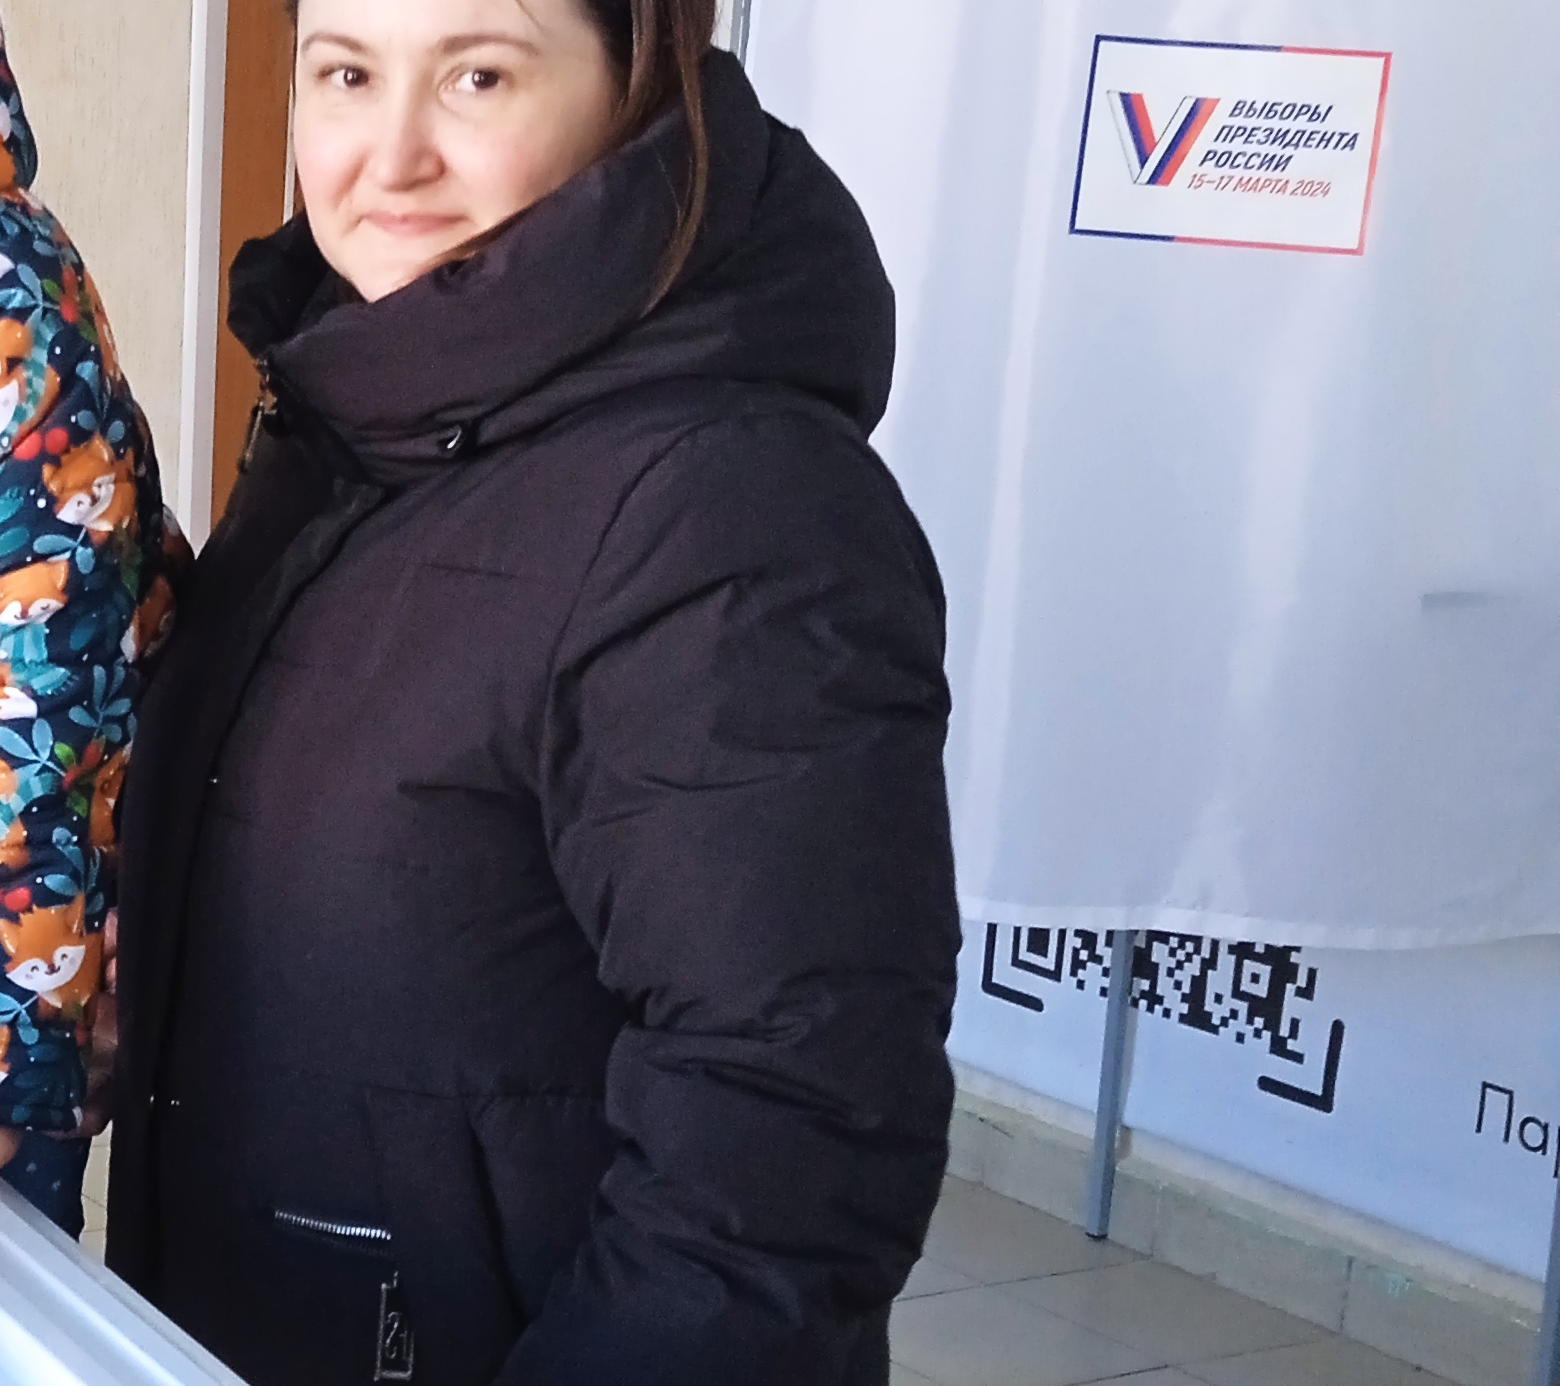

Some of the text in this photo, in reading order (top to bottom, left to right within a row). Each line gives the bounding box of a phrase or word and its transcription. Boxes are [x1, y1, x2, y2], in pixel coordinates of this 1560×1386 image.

[1228, 99, 1333, 124] ВЫБОРЫ
[1213, 124, 1360, 151] ПРЕЗИДЕНТА
[1198, 149, 1295, 173] РОССИИ
[1232, 175, 1291, 196] МАРТА
[1289, 179, 1332, 199] 2024
